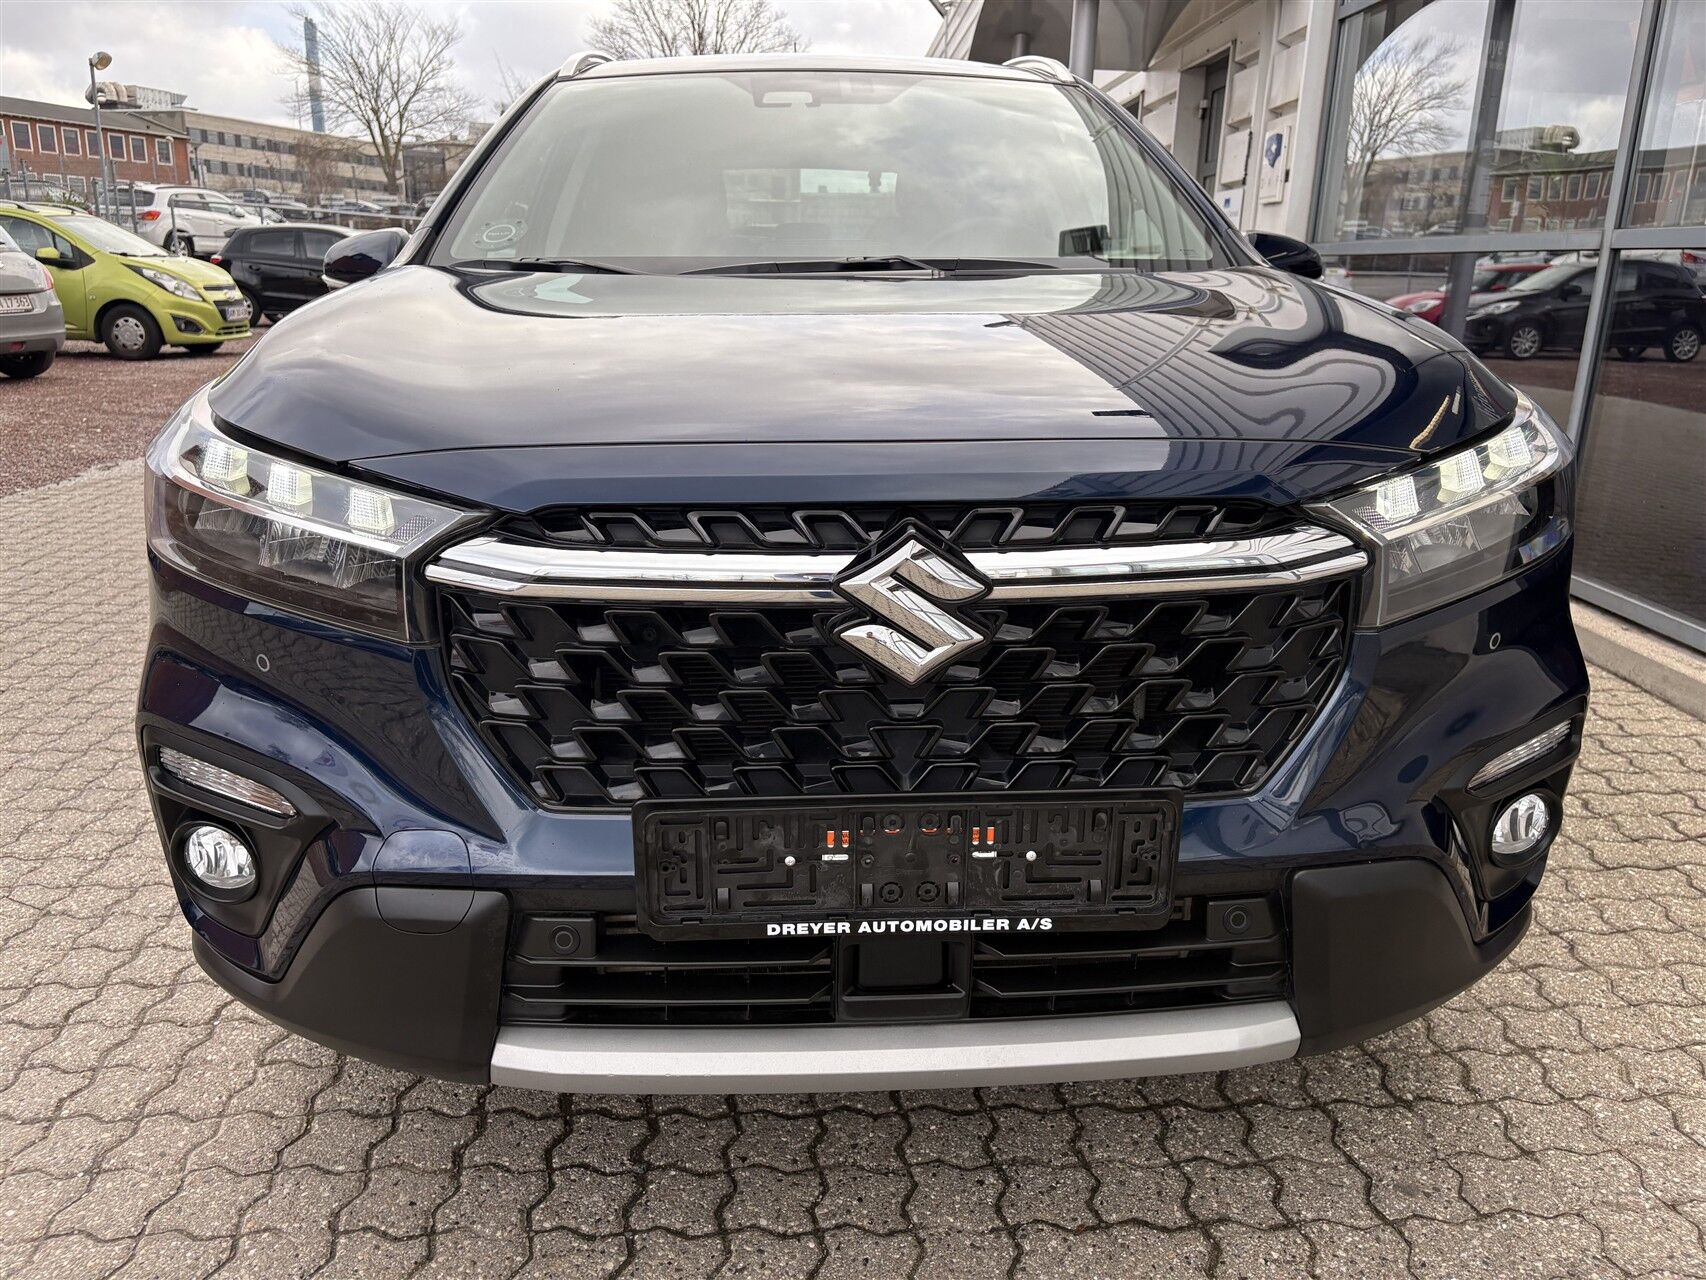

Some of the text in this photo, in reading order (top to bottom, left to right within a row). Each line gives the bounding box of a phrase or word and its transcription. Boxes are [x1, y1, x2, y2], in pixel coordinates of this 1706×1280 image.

[766, 917, 1053, 936] DREYER AUTOMOBILER A/S
